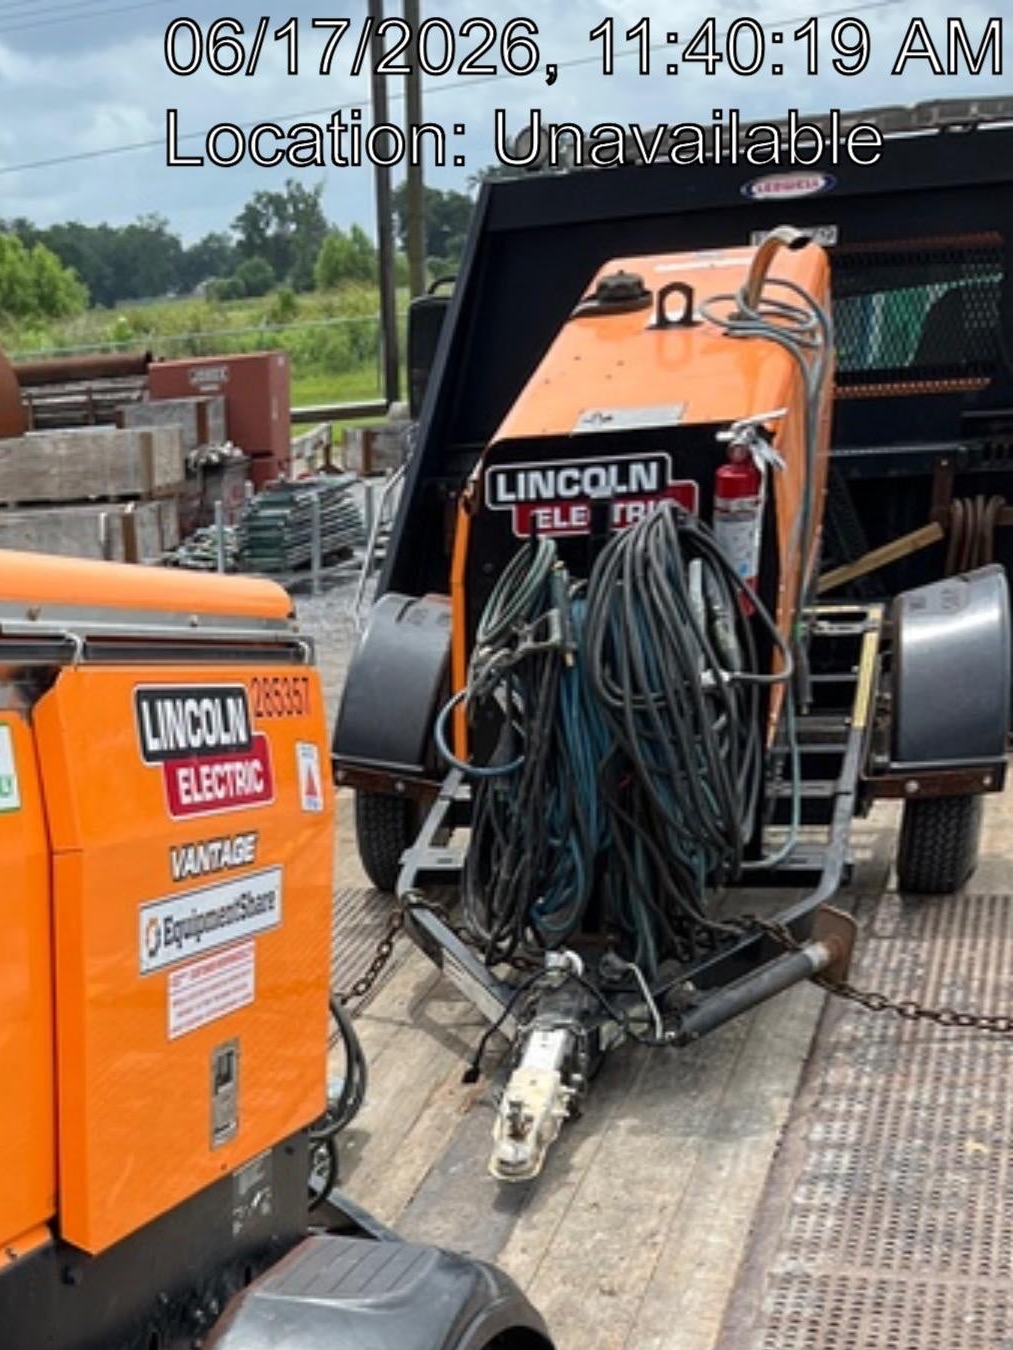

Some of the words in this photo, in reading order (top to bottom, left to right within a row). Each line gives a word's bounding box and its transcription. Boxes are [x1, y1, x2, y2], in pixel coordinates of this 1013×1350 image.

[496, 461, 659, 503] LINCOLN
[142, 696, 249, 752] LINCOLN
[175, 758, 266, 806] ELECTRIC
[169, 829, 259, 883] VANTAGE
[162, 889, 277, 950] EquipmentShare
